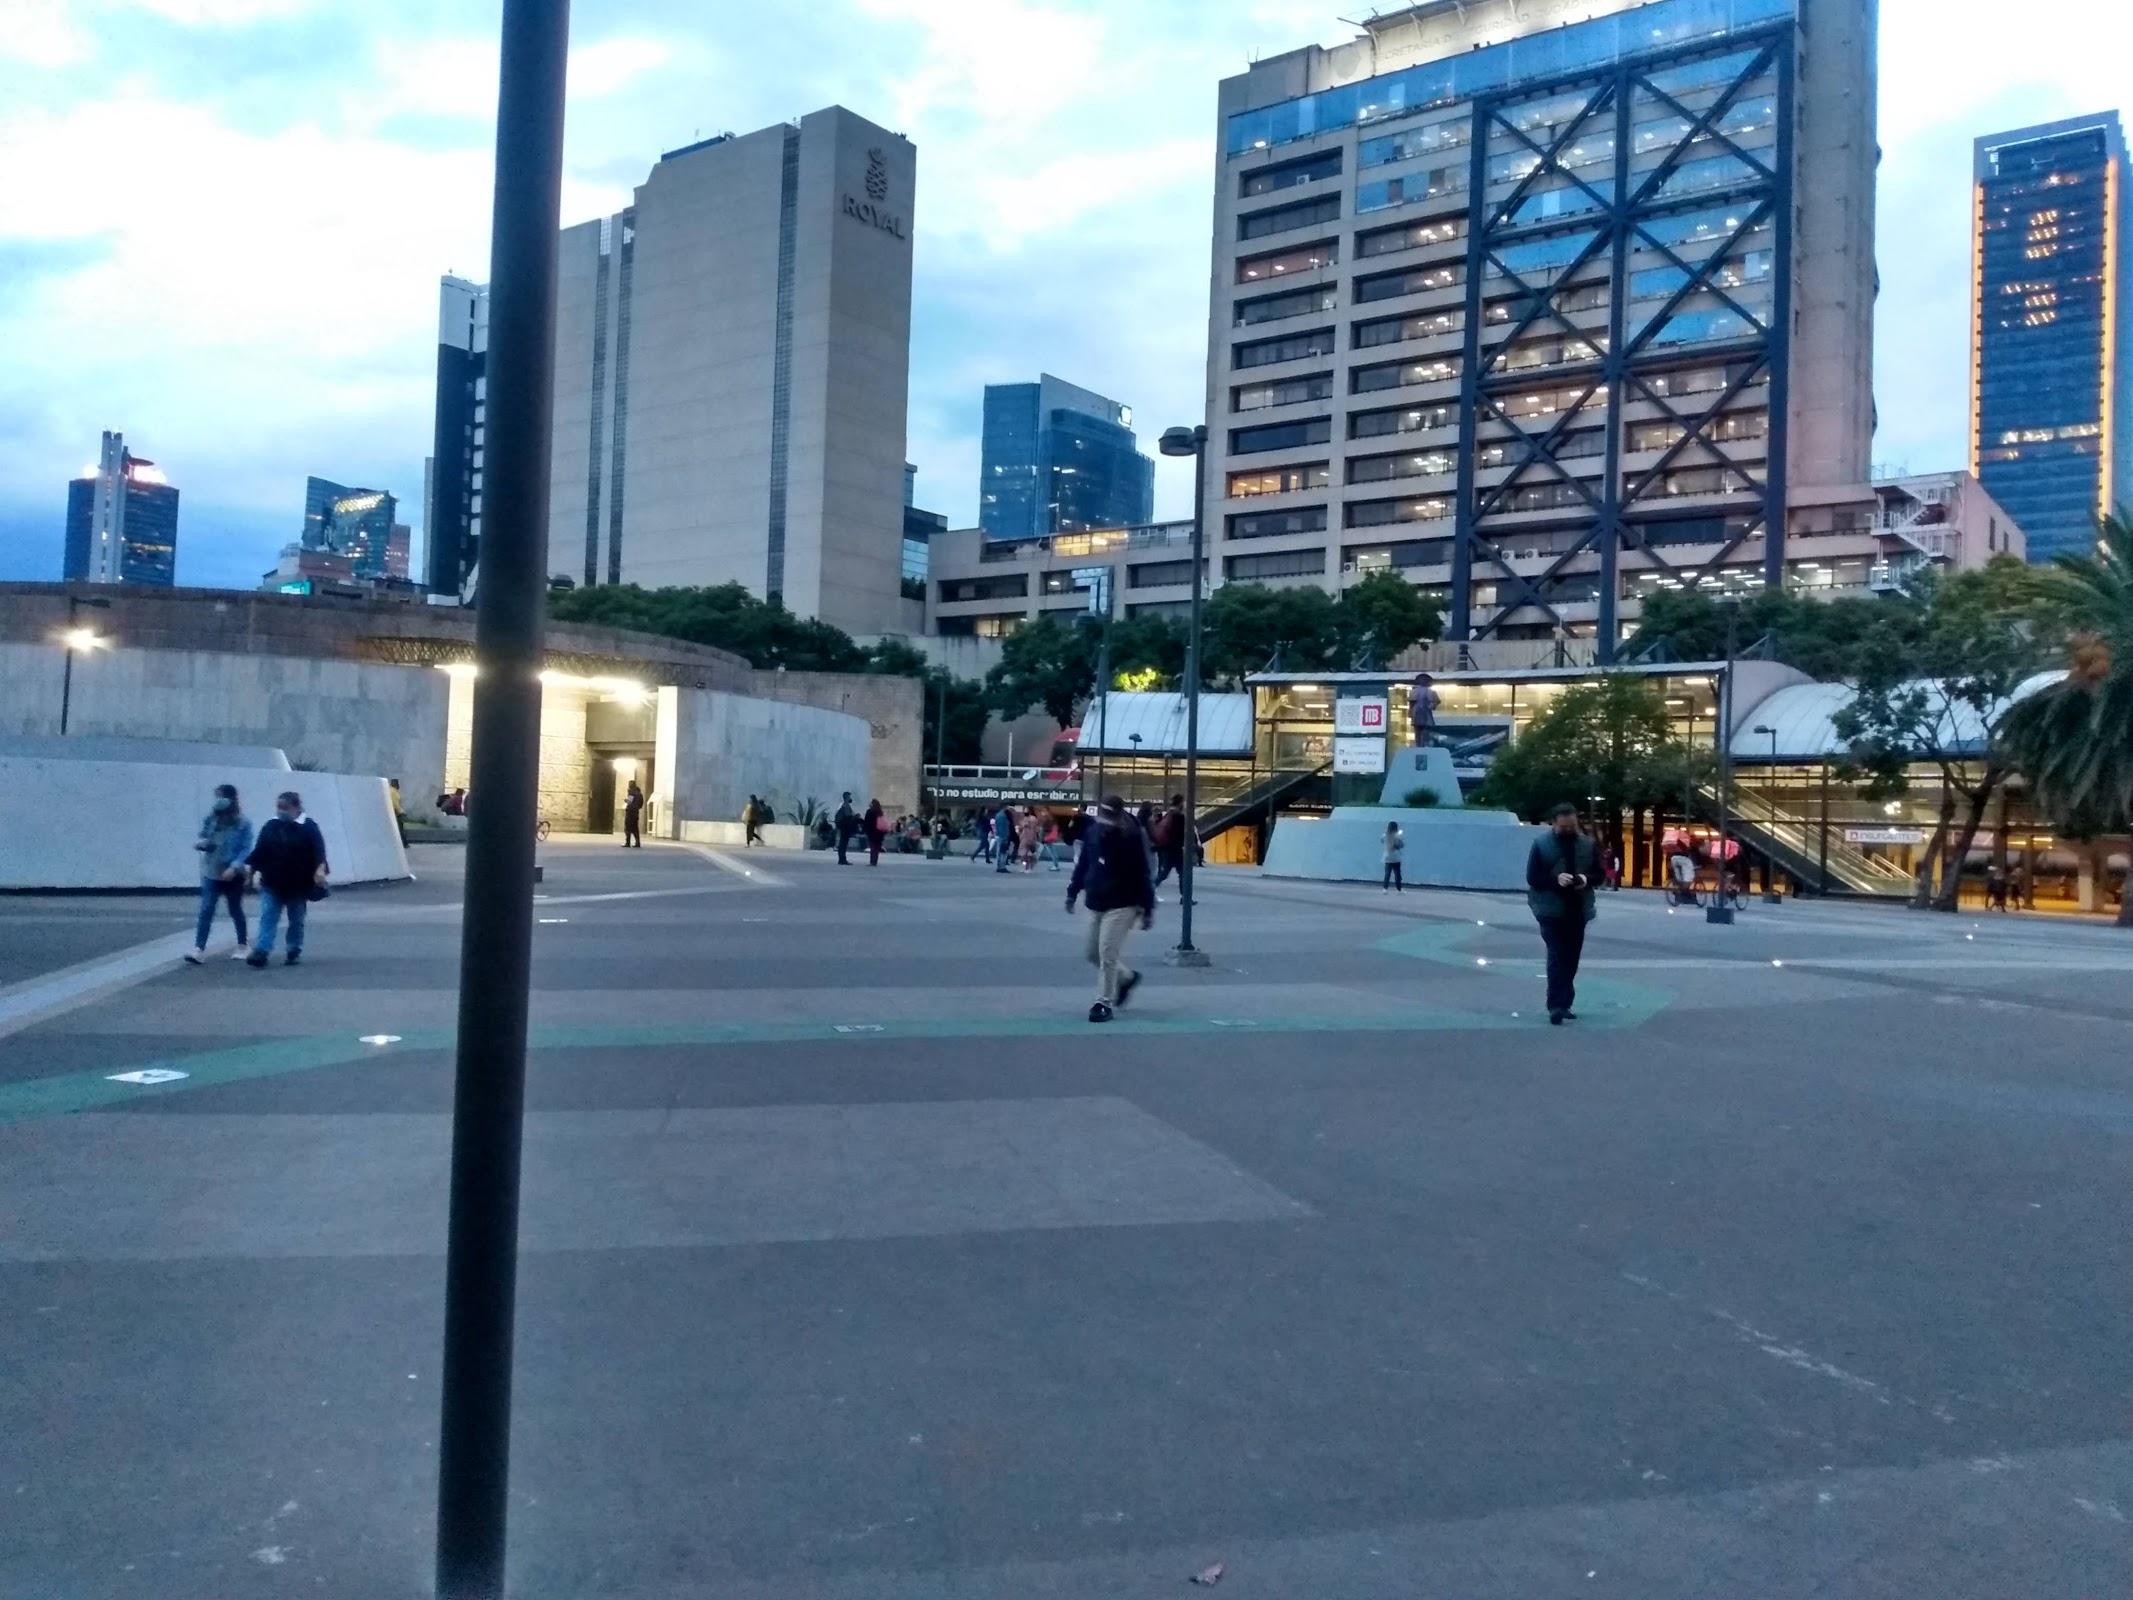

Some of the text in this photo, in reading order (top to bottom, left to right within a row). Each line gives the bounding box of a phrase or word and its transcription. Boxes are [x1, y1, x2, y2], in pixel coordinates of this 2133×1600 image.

[842, 193, 905, 240] ROYAL
[946, 788, 959, 798] no
[961, 788, 999, 799] estudio
[1001, 790, 1025, 800] para
